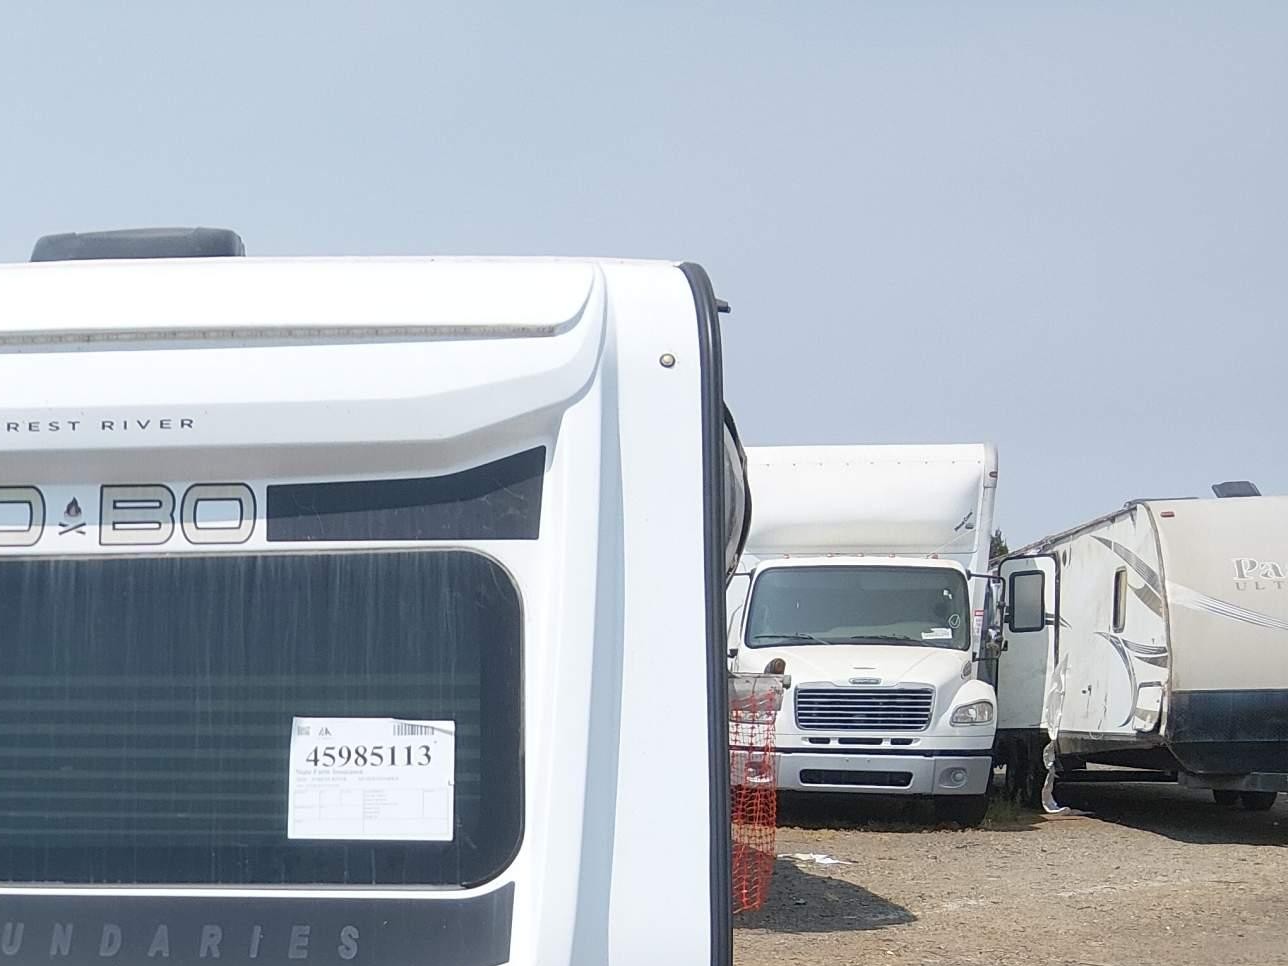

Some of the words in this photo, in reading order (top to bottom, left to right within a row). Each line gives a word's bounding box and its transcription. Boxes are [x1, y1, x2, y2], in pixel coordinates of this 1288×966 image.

[101, 418, 195, 432] RIVER
[98, 482, 257, 546] BO
[306, 744, 432, 767] 45985113
